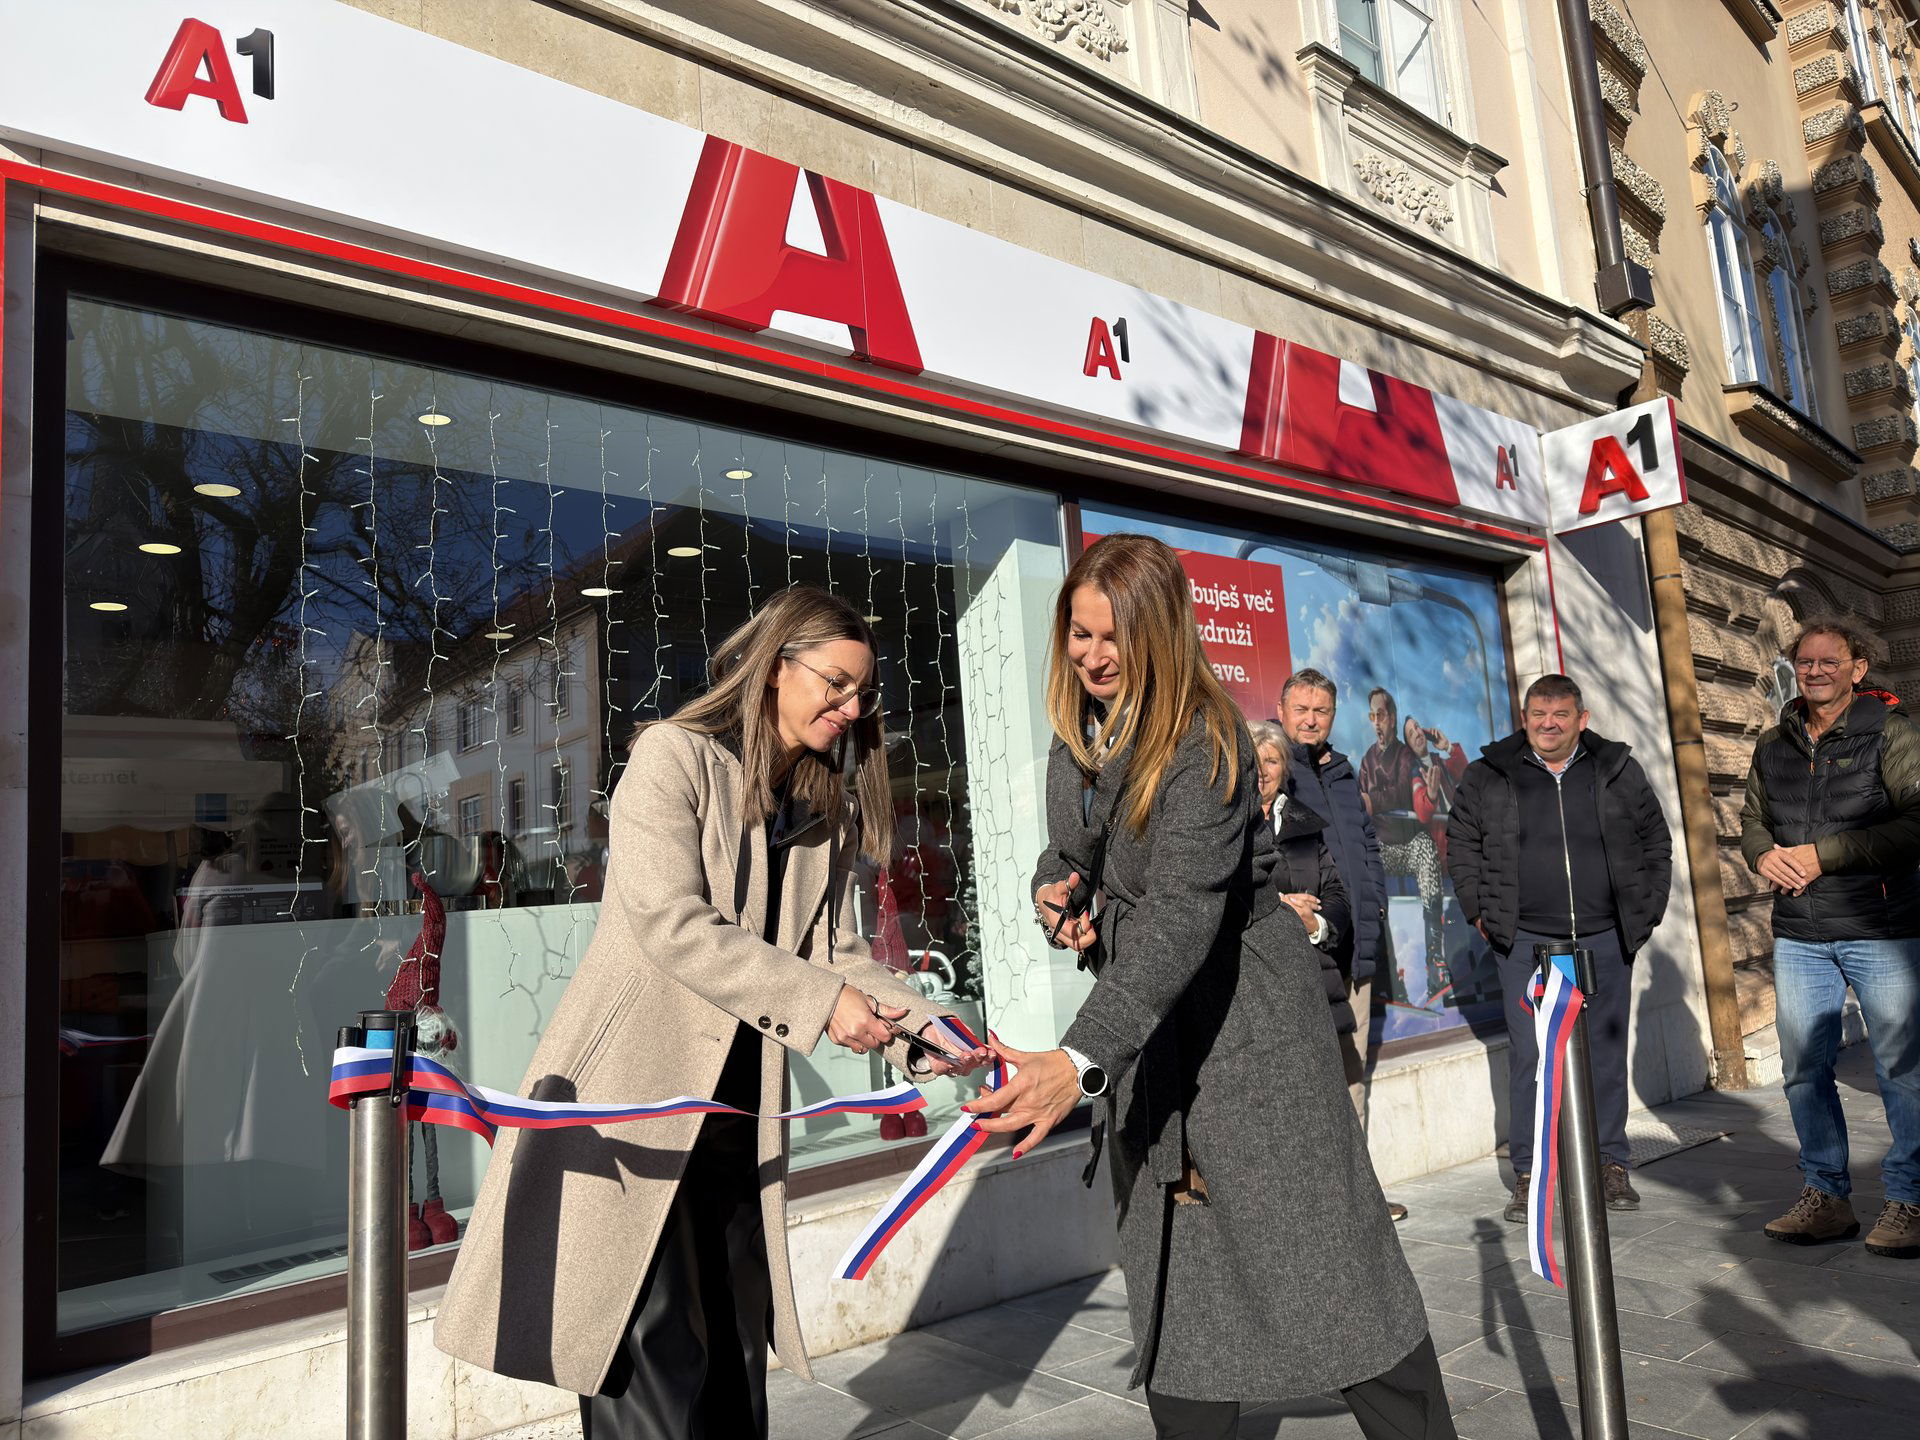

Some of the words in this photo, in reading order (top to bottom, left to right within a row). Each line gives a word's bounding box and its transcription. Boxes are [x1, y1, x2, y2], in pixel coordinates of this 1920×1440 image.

[144, 17, 274, 124] A1
[1083, 316, 1130, 381] A1
[1496, 444, 1520, 491] A1
[1578, 413, 1659, 515] A1
[1189, 578, 1240, 611] buješ
[1243, 589, 1275, 613] več
[1210, 662, 1250, 683] ave.
